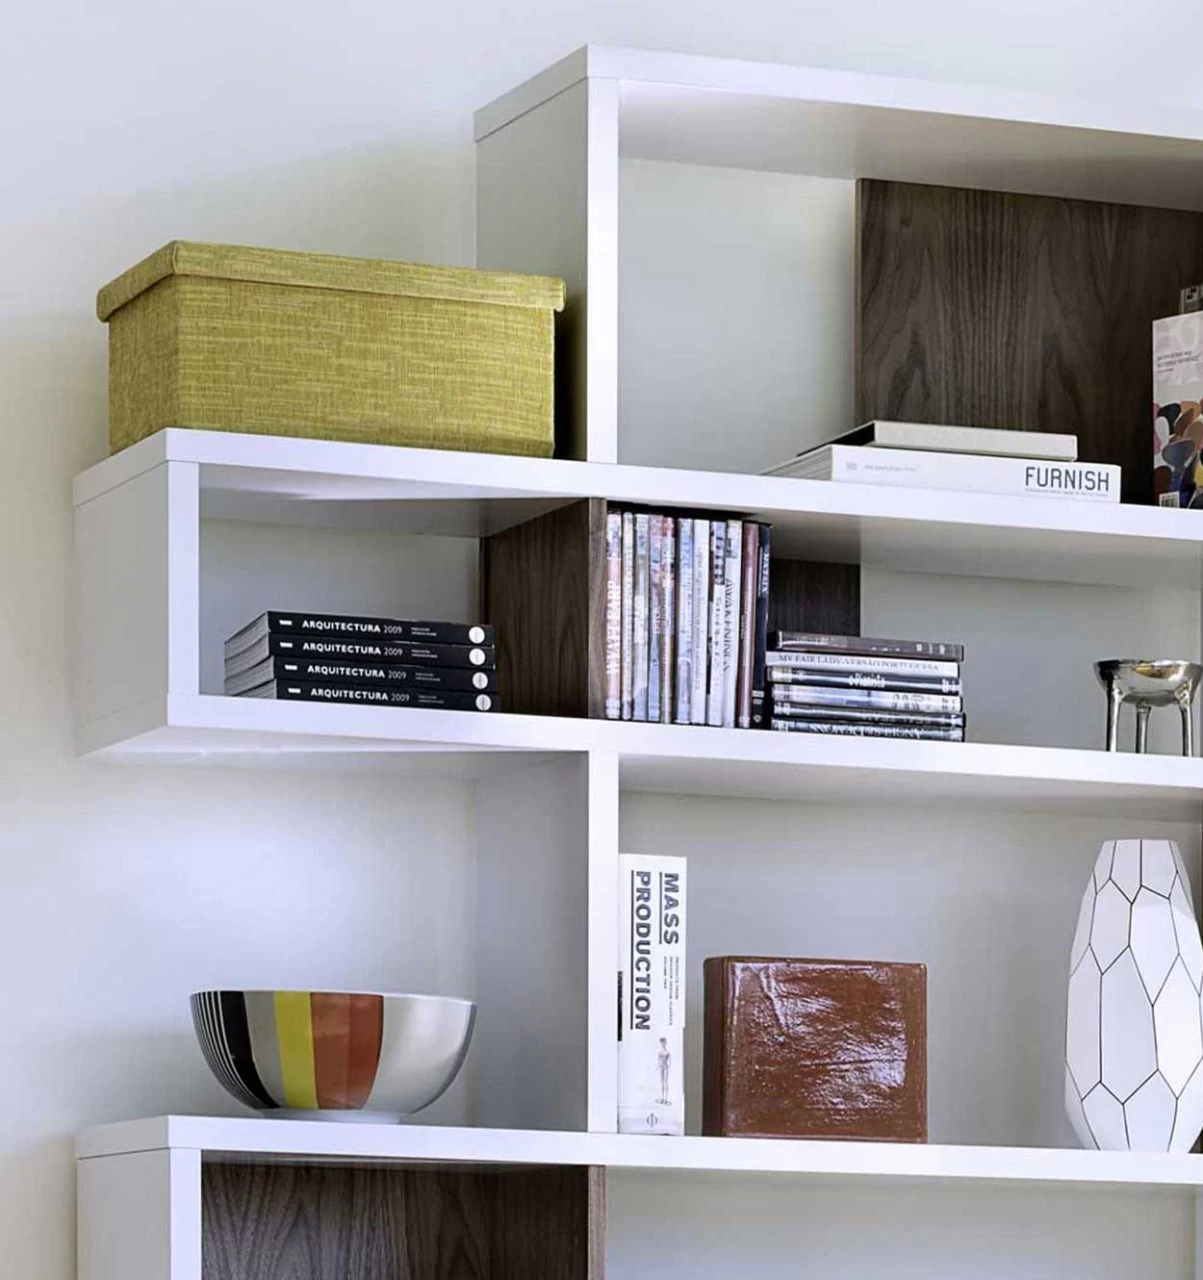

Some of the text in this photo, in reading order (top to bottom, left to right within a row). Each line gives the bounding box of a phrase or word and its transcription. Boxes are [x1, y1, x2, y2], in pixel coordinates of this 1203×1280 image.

[1025, 466, 1110, 492] FURNISH
[302, 620, 380, 633] ARQUITECTURA
[384, 624, 402, 634] 2009
[303, 642, 381, 655] ARQUITECTURA
[384, 647, 403, 656] 2009
[307, 665, 385, 678] ARQUITECTURA
[388, 670, 406, 680] 2009
[311, 688, 388, 701] ARQUITECTURA
[663, 872, 679, 945] MASS
[635, 871, 652, 1031] PRODUCTION
